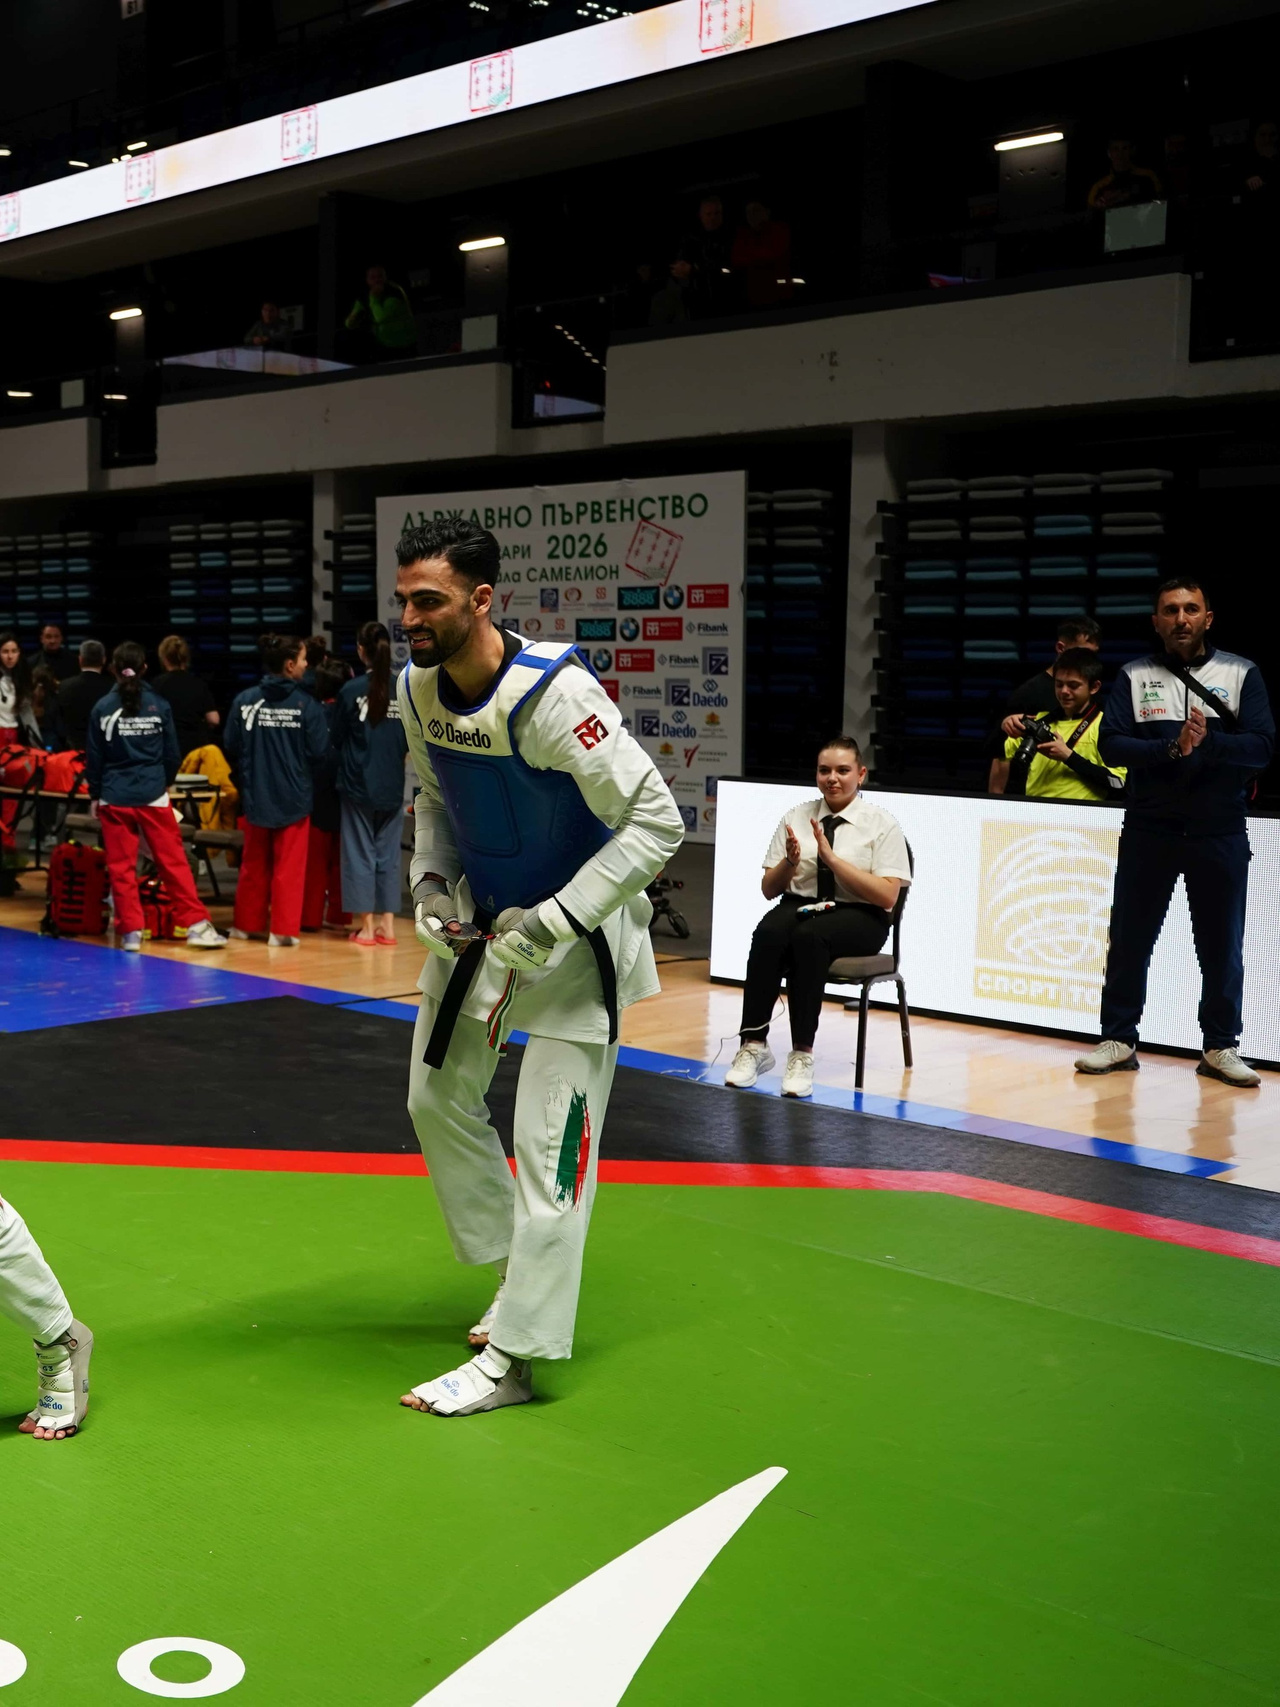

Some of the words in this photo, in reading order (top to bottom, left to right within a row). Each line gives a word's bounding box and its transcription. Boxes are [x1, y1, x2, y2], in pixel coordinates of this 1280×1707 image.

[542, 492, 709, 527] ПЪРВЕНСТВО
[501, 544, 531, 560] АРИ
[547, 532, 608, 560] 2026
[526, 564, 619, 583] САМЕЛИОН
[697, 622, 728, 633] Fibank
[669, 654, 699, 665] Fibank
[632, 686, 662, 696] Fibank
[692, 692, 728, 708] Daedo
[445, 722, 491, 749] Daedo
[662, 723, 697, 738] Daedo
[516, 942, 535, 958] Daedo
[977, 972, 1061, 1001] СПОРТ
